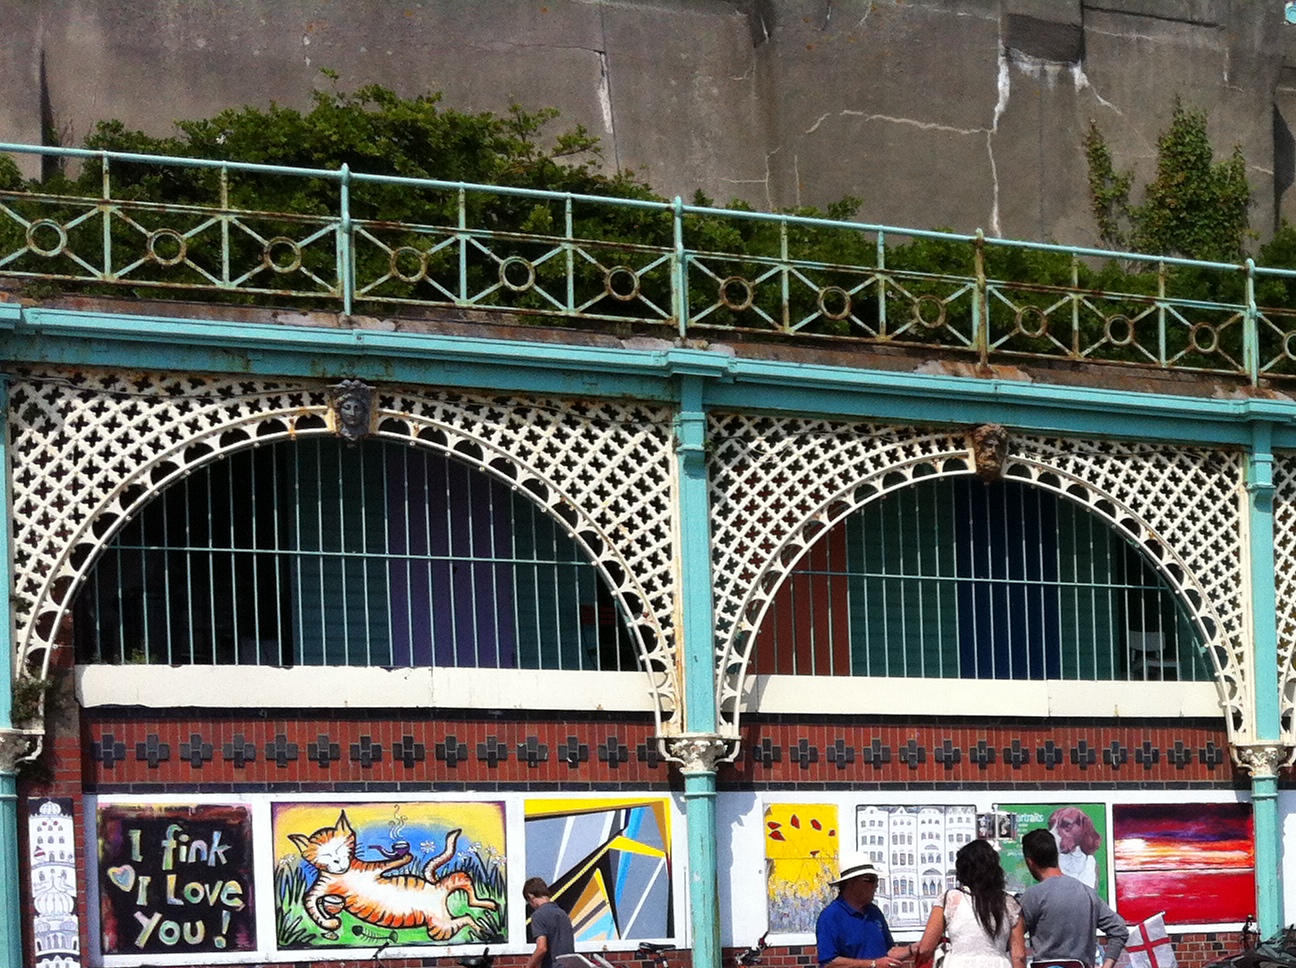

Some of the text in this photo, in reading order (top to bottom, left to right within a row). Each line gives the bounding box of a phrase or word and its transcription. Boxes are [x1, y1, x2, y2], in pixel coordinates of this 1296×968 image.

[128, 824, 232, 870] I fink
[136, 874, 246, 912] I Love
